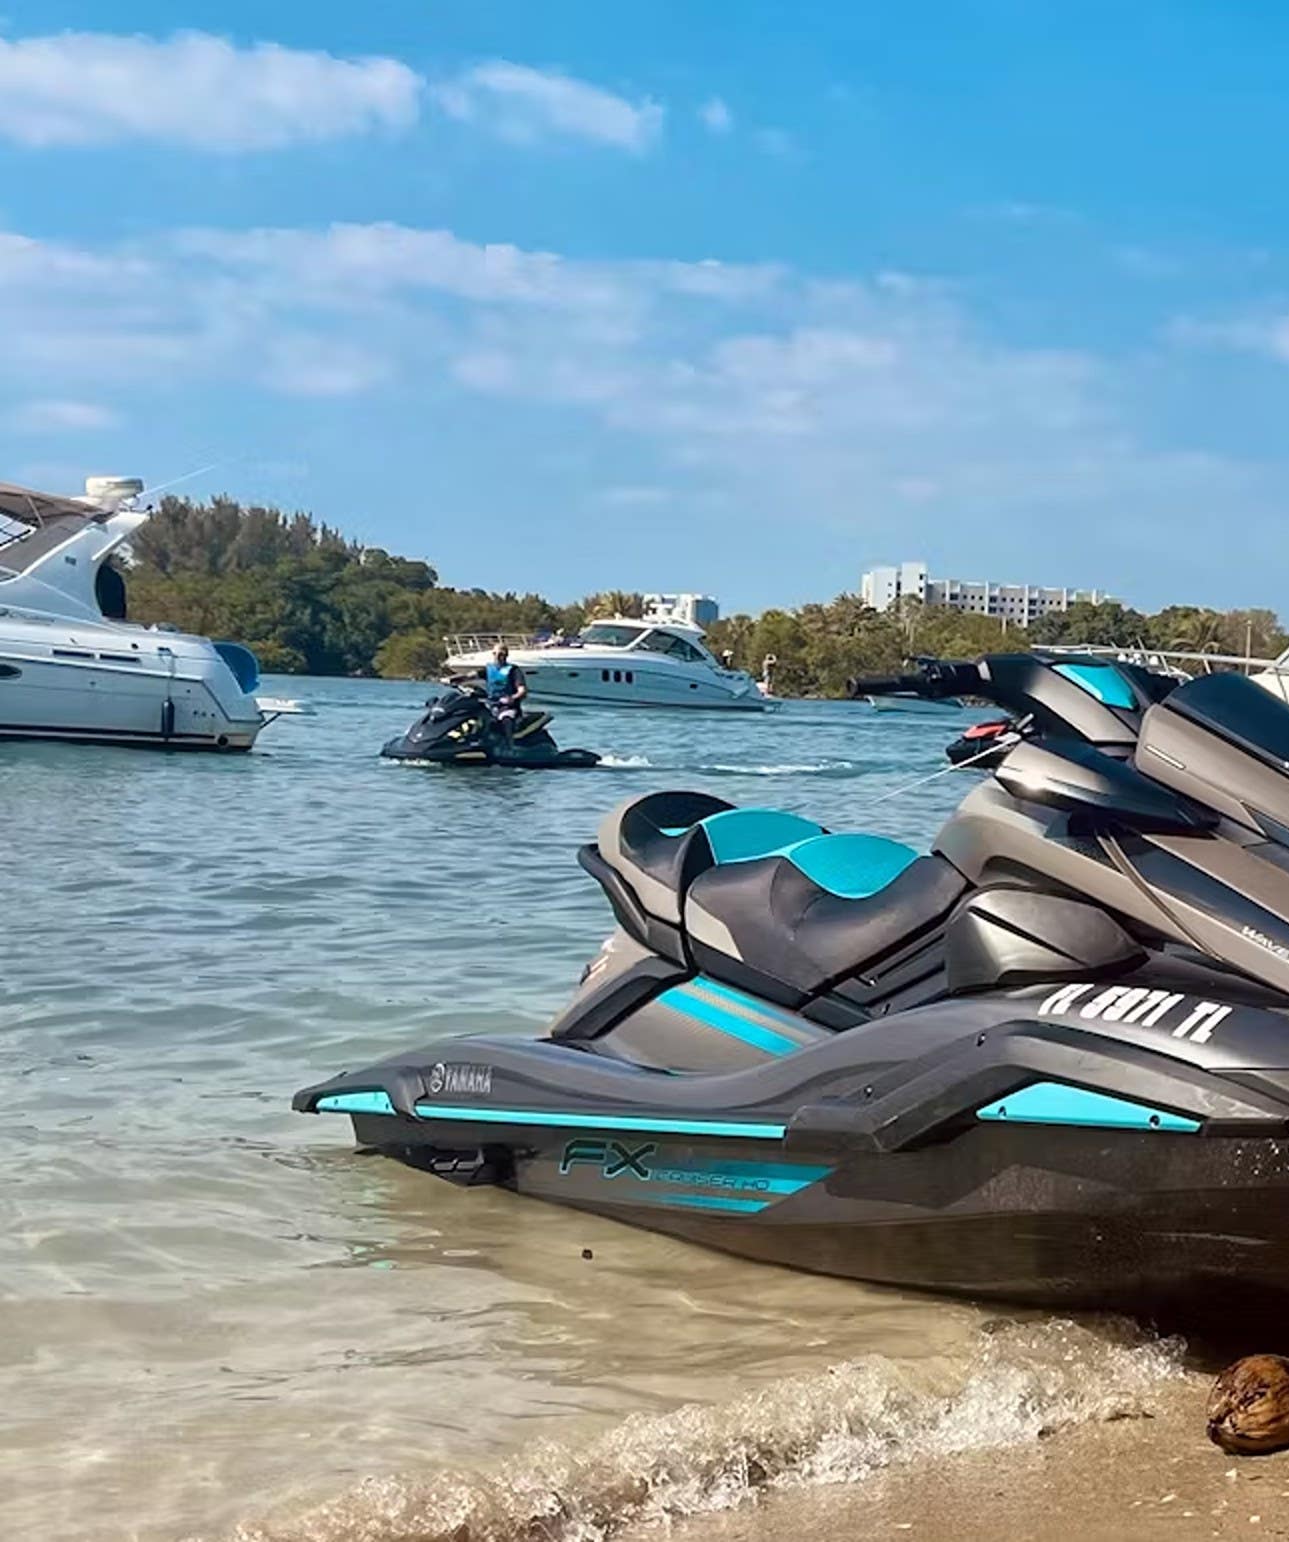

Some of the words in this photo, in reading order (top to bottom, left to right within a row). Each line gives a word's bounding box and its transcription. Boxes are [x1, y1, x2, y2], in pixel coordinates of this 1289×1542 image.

[1037, 983, 1095, 1016] FL
[1079, 985, 1185, 1027] 5971
[1171, 1001, 1232, 1044] TL
[445, 1064, 493, 1093] YAMAHA
[559, 1137, 657, 1181] FX
